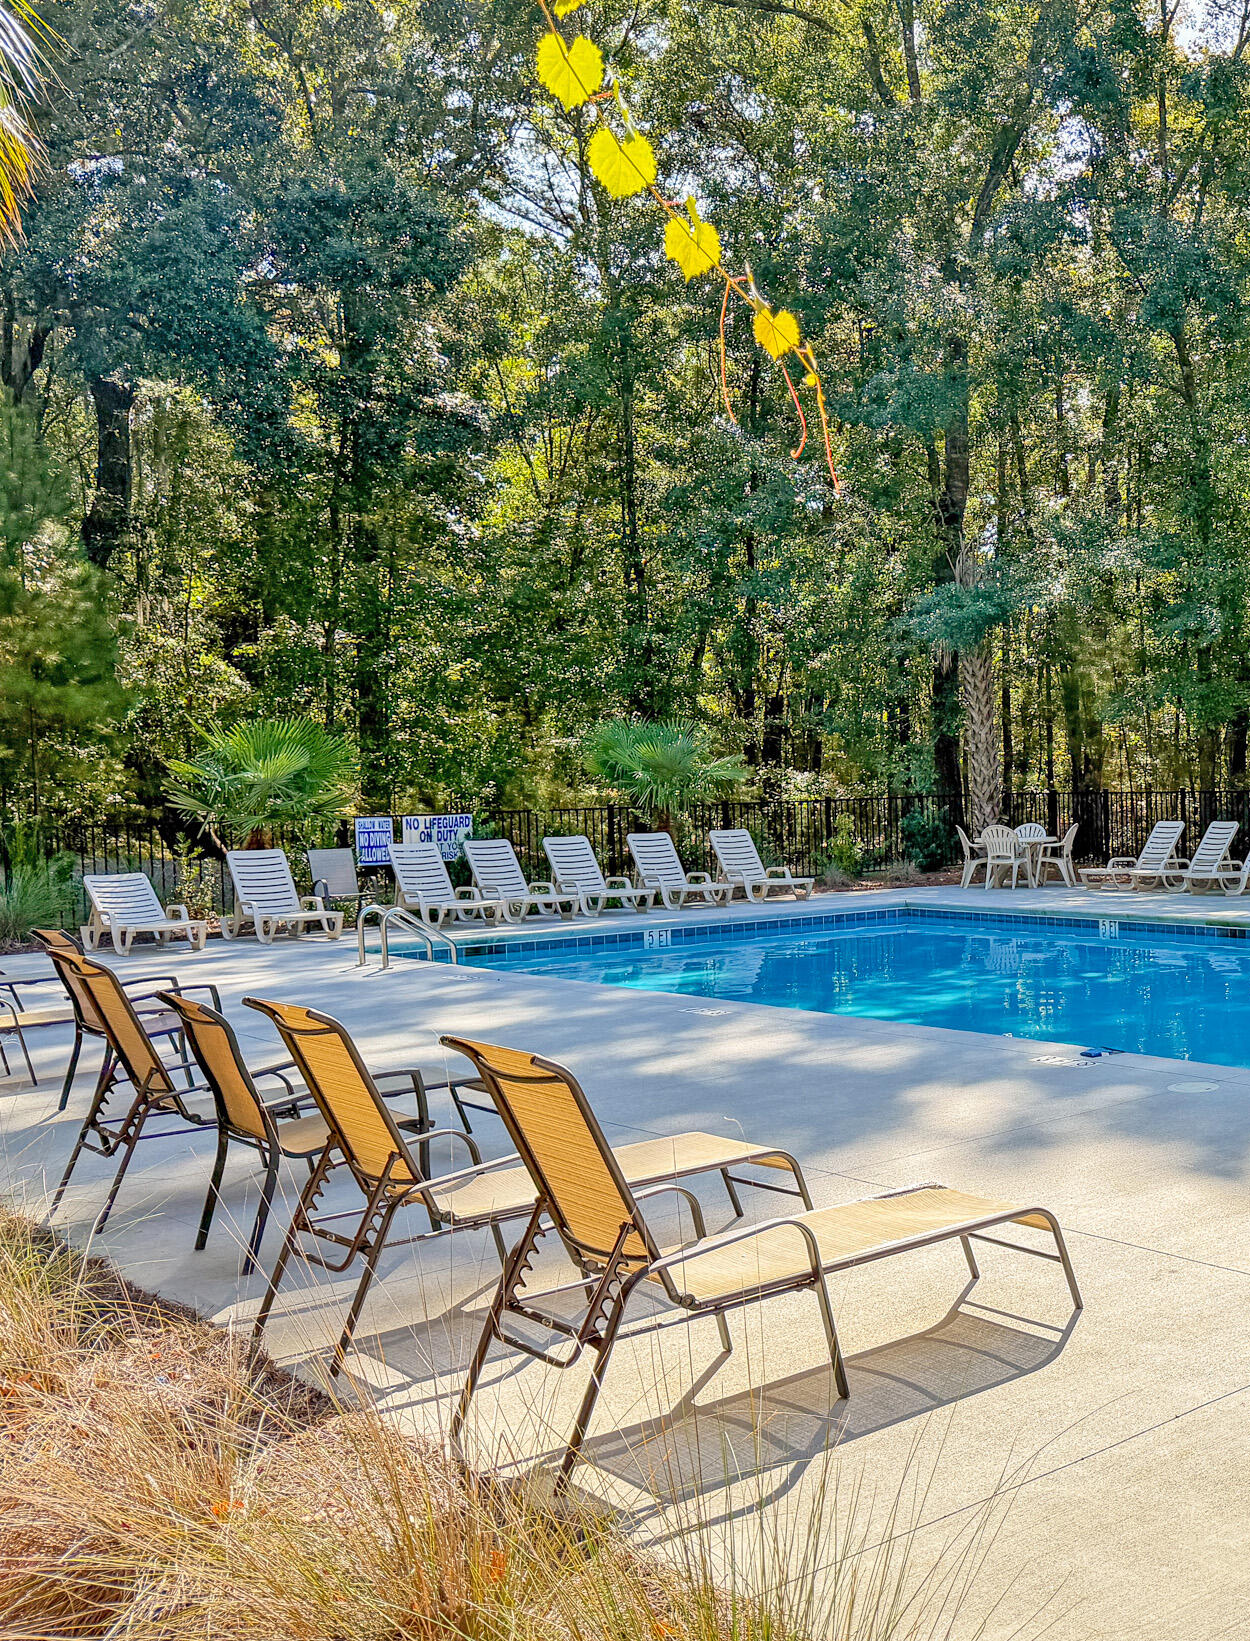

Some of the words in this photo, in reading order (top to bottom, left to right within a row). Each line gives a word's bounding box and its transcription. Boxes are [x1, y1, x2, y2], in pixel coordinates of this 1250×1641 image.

[406, 818, 420, 830] NO
[424, 816, 471, 830] LIFEGUARD
[360, 832, 369, 846] NO
[369, 832, 391, 846] DIVING
[420, 831, 432, 842] ON
[437, 829, 459, 842] DUTY
[441, 851, 458, 860] RISK
